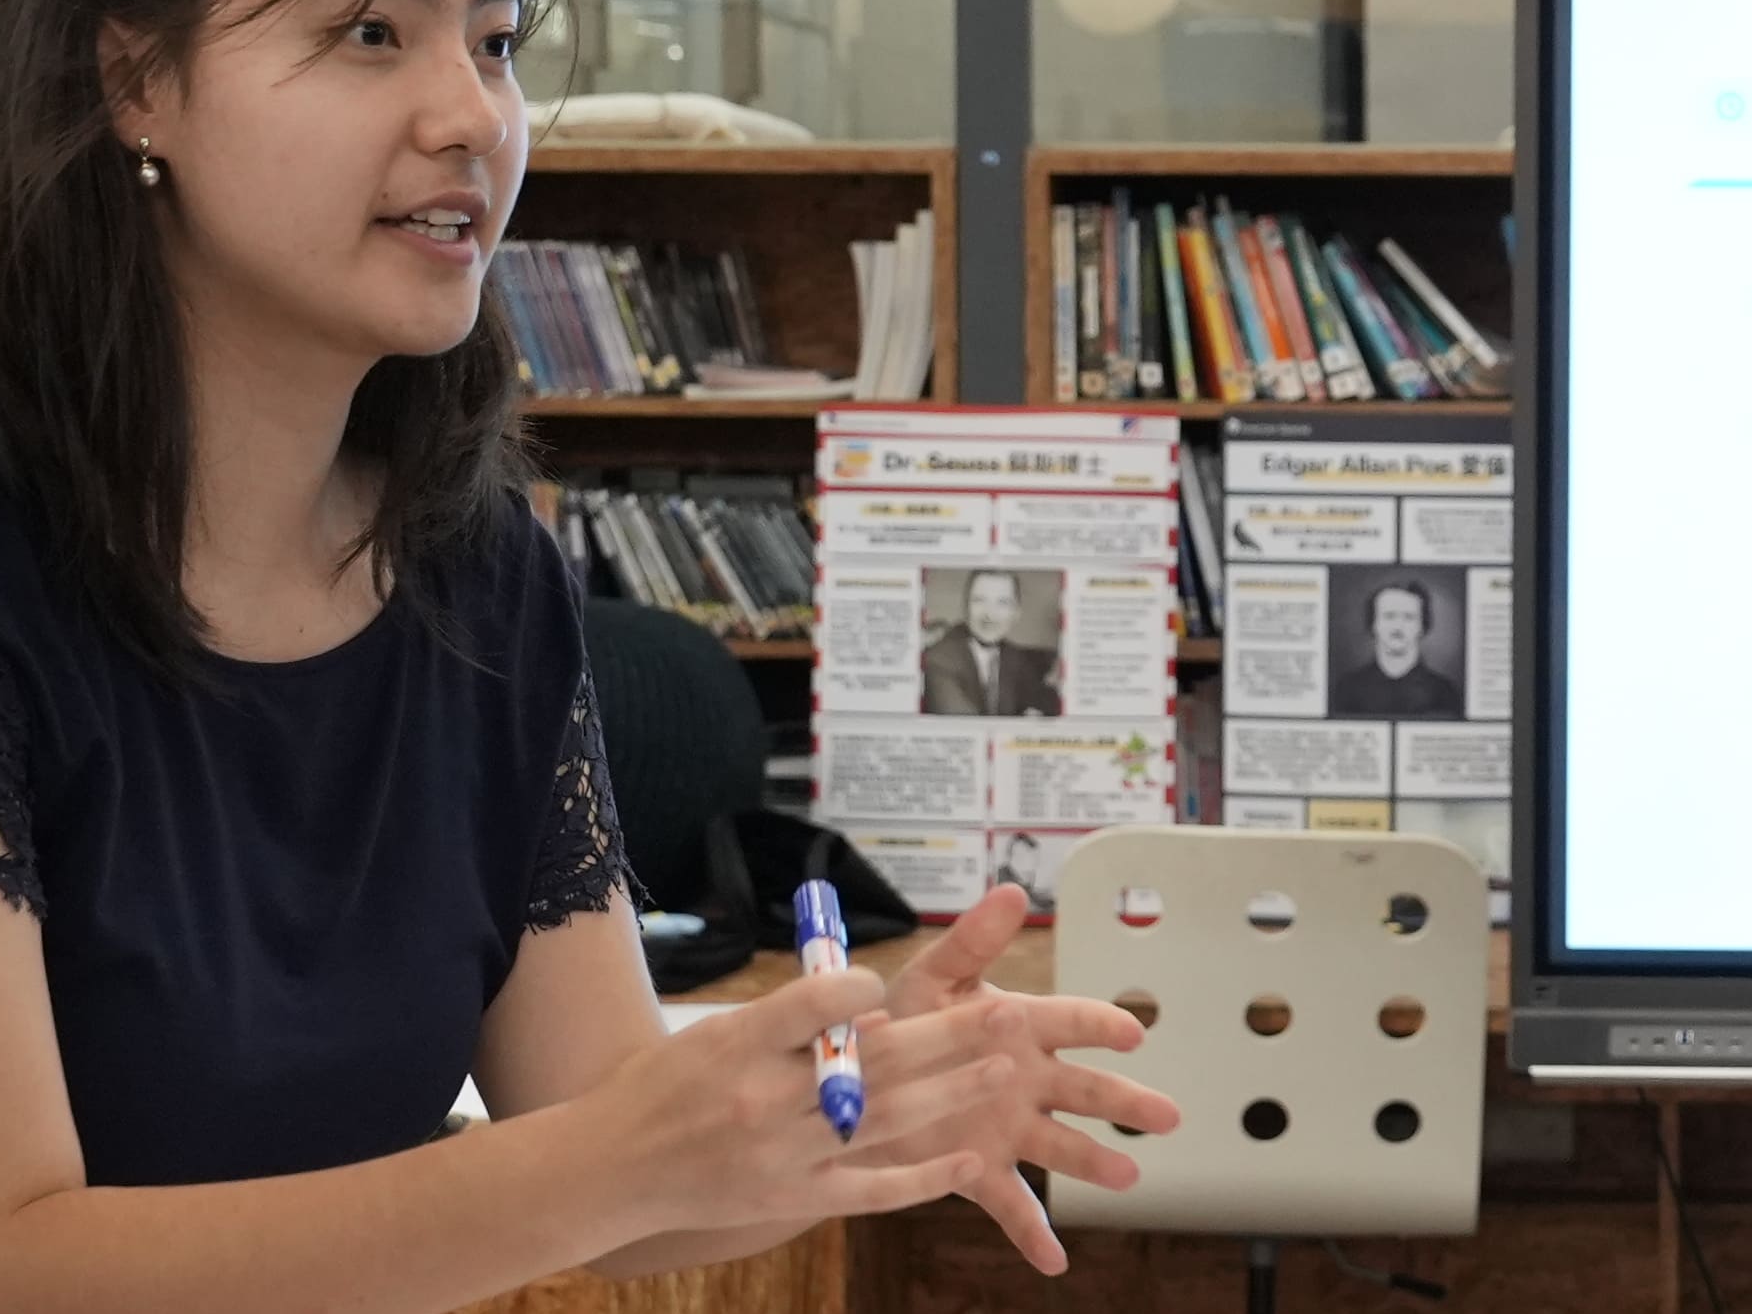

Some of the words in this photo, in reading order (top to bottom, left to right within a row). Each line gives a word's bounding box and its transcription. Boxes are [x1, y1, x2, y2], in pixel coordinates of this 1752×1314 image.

[926, 449, 1000, 473] Seuss
[1260, 451, 1330, 479] Edgar
[1340, 452, 1400, 475] Allan
[1405, 454, 1452, 476] Poe
